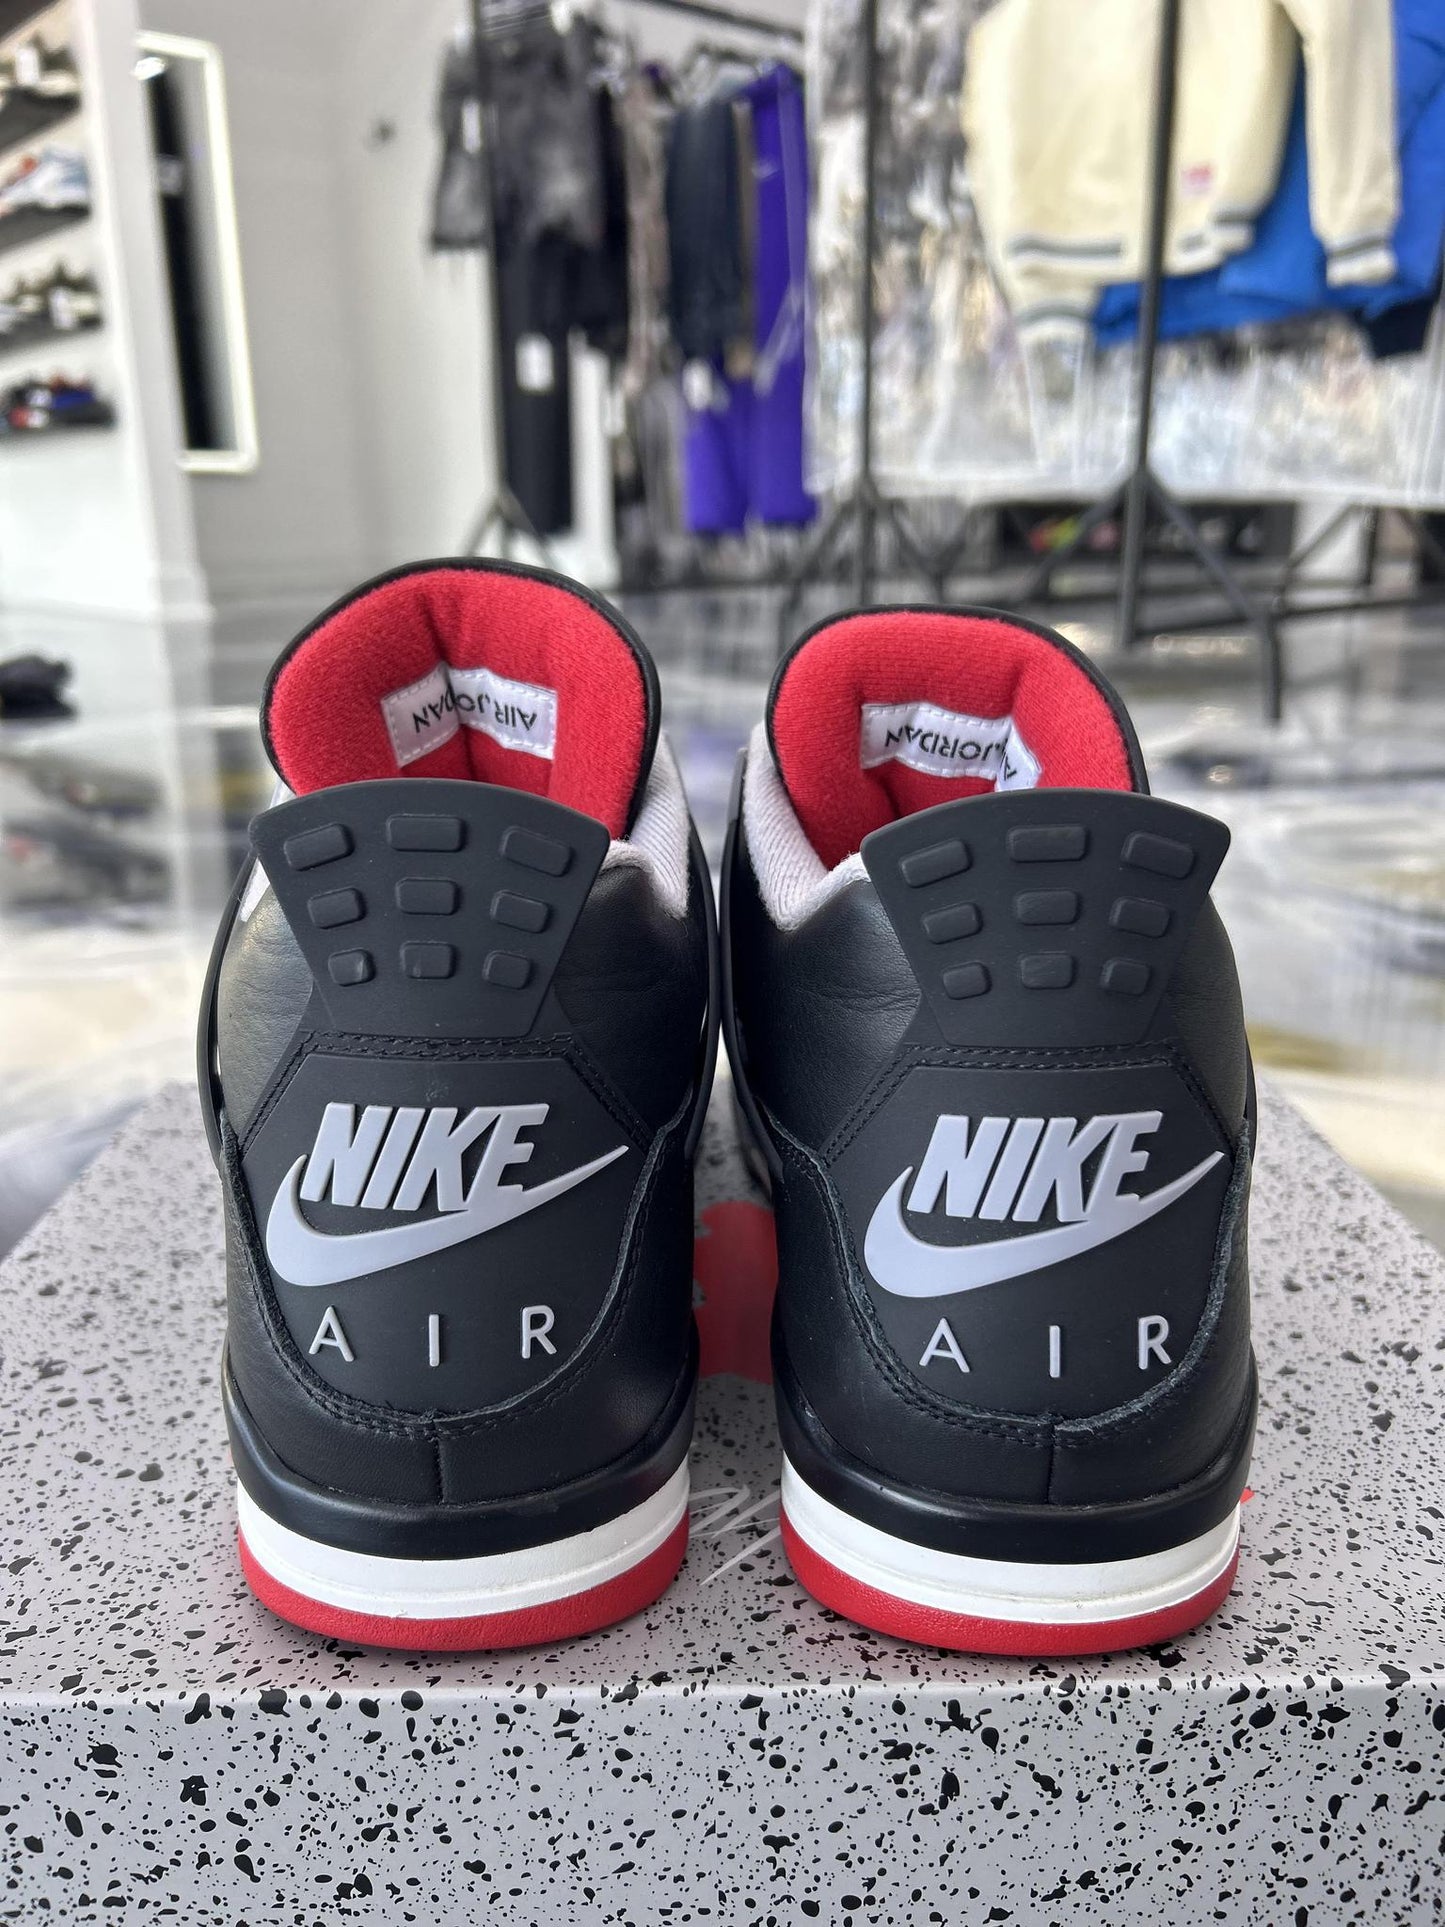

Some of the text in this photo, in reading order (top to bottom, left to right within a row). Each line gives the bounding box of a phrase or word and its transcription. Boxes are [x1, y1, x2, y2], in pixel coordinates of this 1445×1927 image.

[412, 689, 537, 733] AIR JODAN
[884, 725, 1001, 762] JORDAN
[300, 1101, 550, 1213] NIKE
[907, 1110, 1164, 1223] NIKE
[308, 1304, 558, 1368] AIR
[918, 1314, 1173, 1379] AIR
